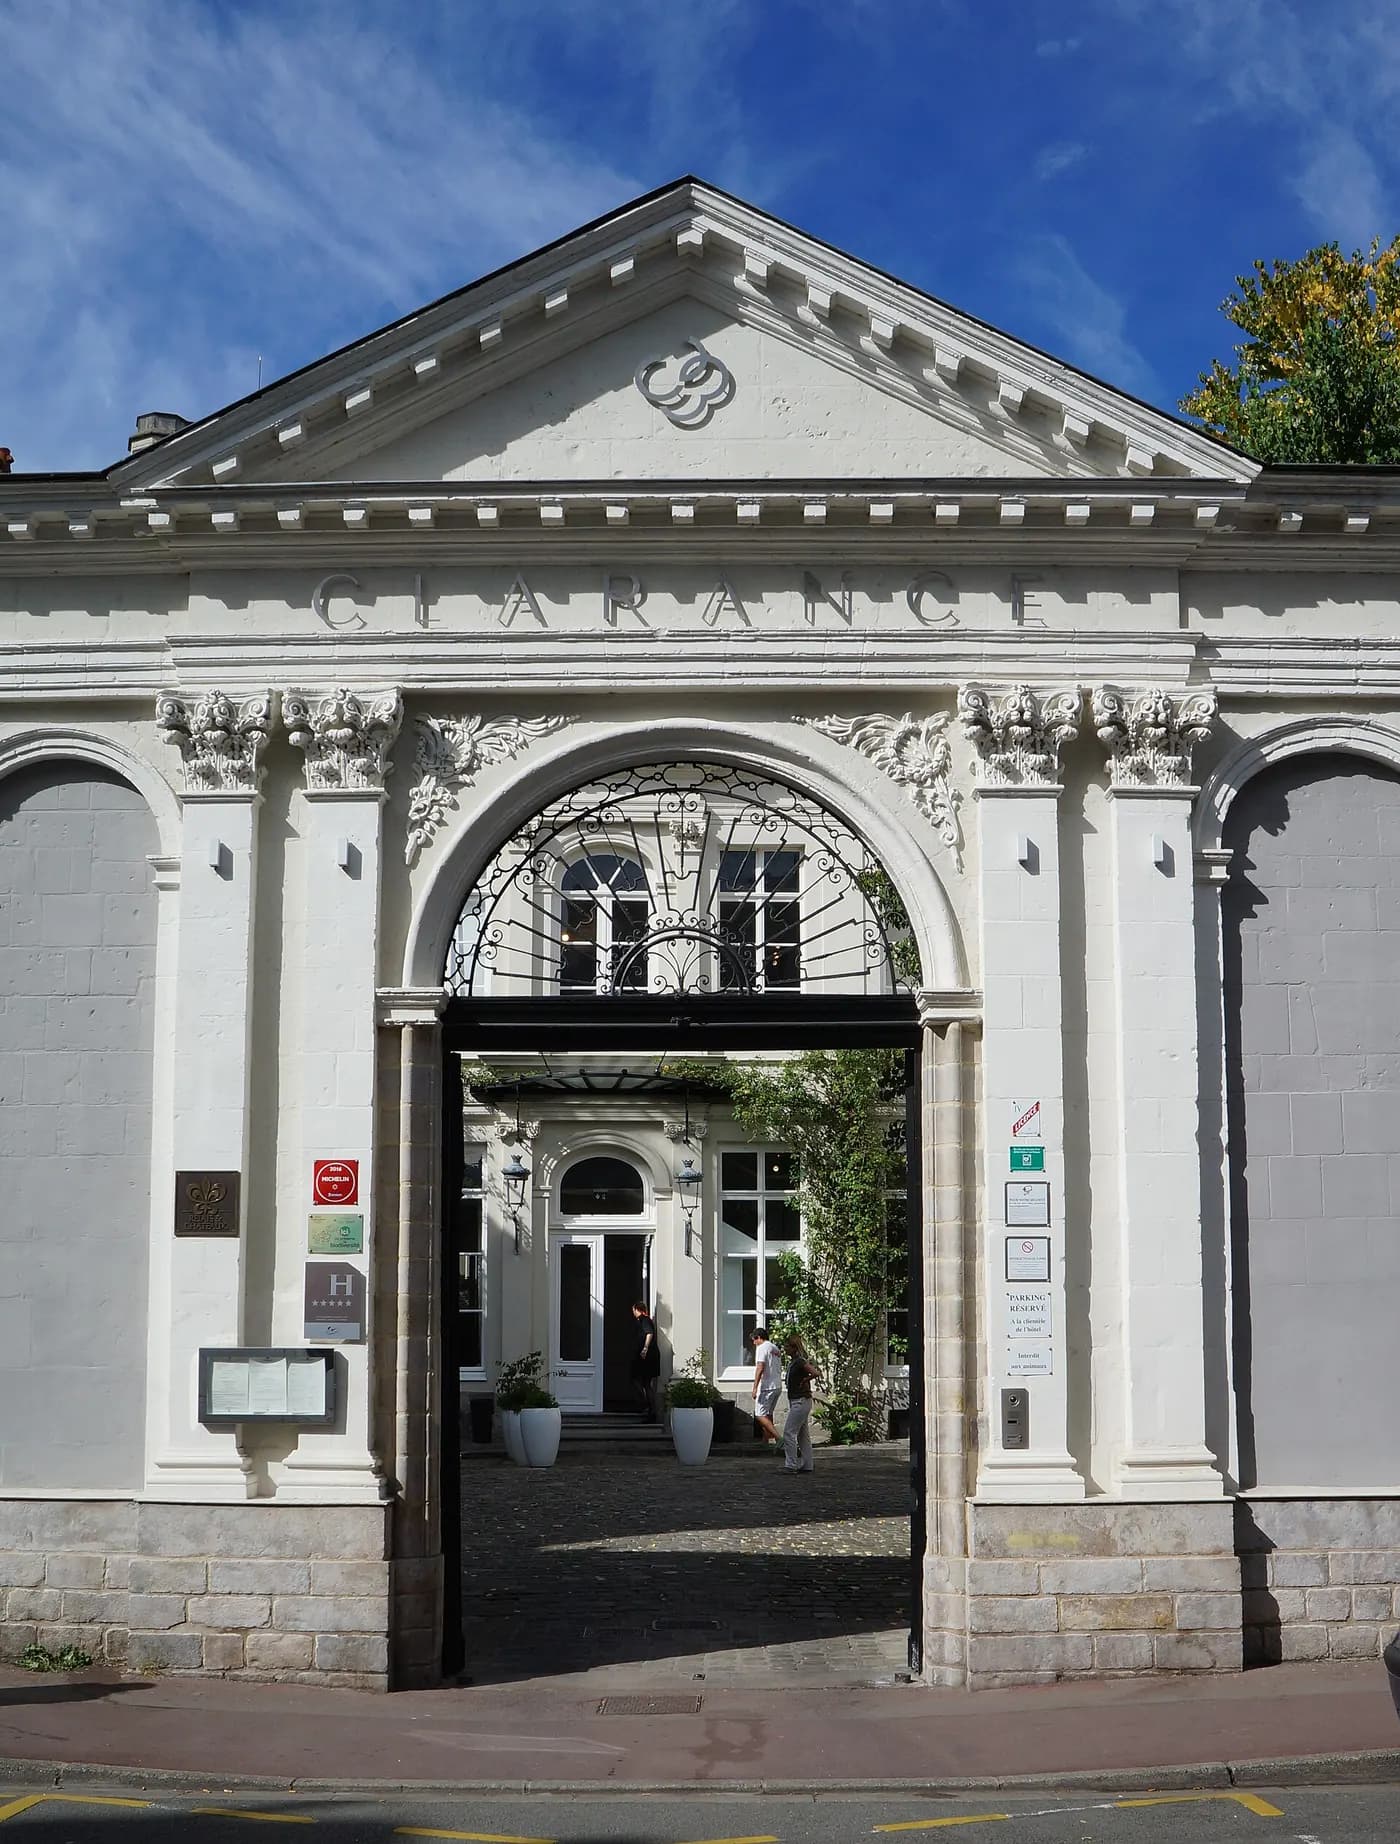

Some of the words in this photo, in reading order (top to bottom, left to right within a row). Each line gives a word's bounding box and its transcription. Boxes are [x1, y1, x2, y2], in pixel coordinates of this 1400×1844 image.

[311, 570, 1048, 630] CLARANCE
[1014, 1103, 1039, 1131] LICENCE
[328, 1274, 353, 1296] H
